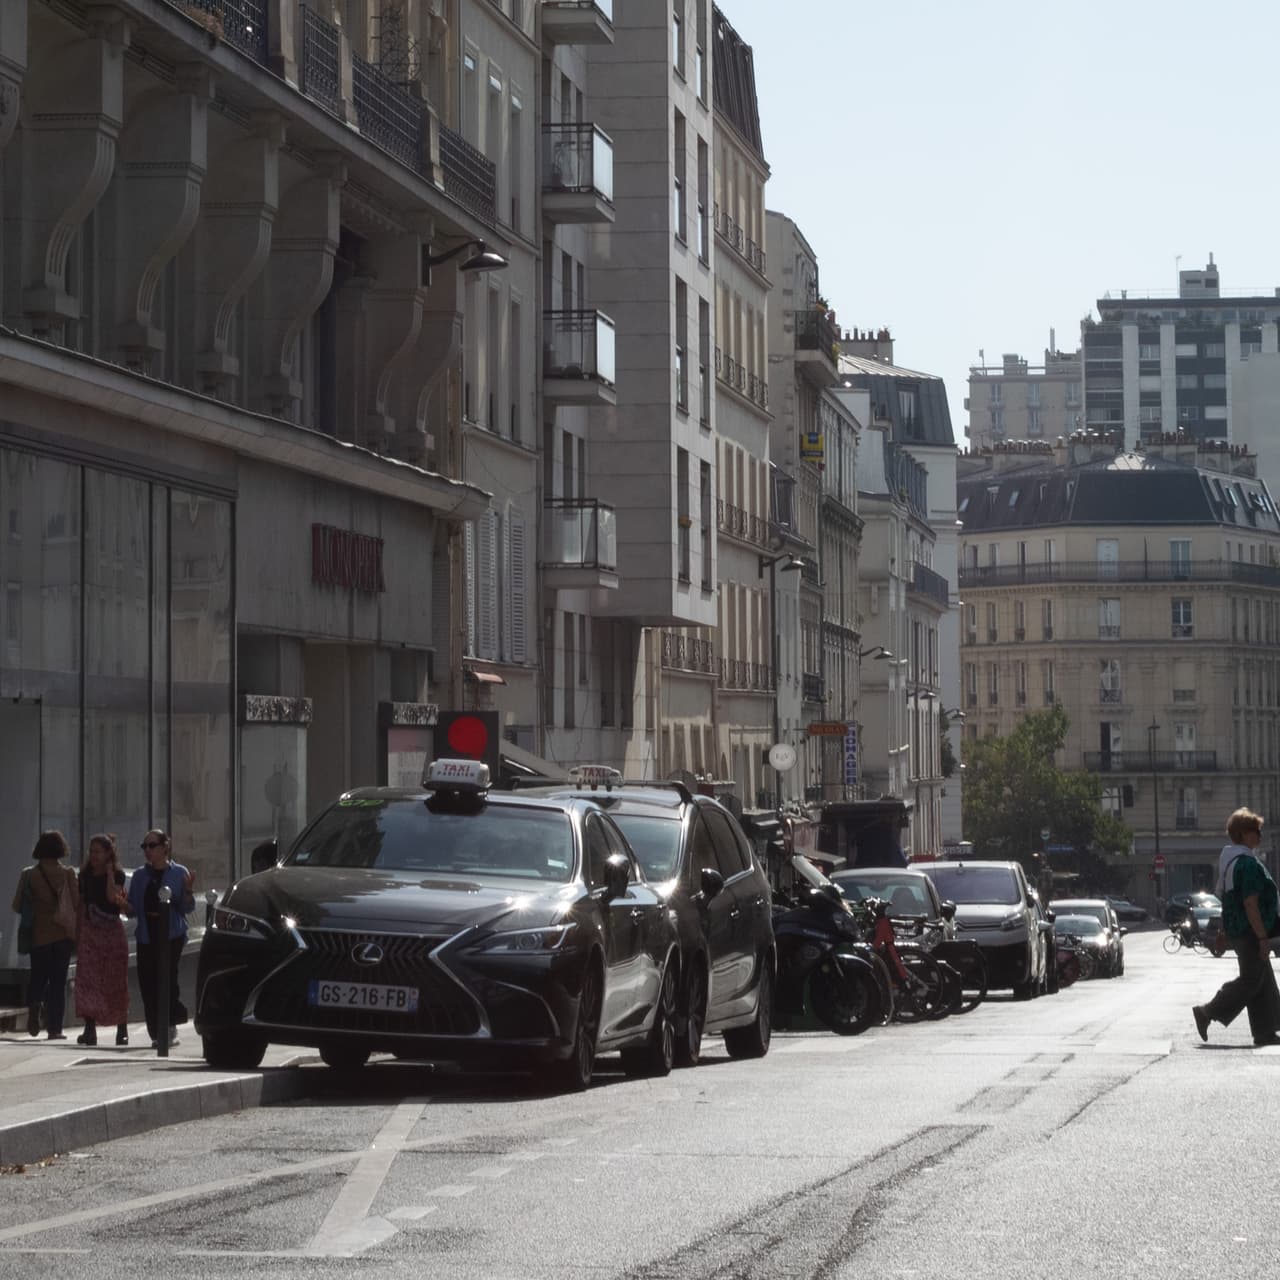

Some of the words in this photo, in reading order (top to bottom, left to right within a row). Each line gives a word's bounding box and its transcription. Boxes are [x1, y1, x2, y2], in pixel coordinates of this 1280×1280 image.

[442, 764, 470, 772] TAXI
[582, 767, 606, 777] TAXI
[321, 984, 407, 1008] GS-216-FB
